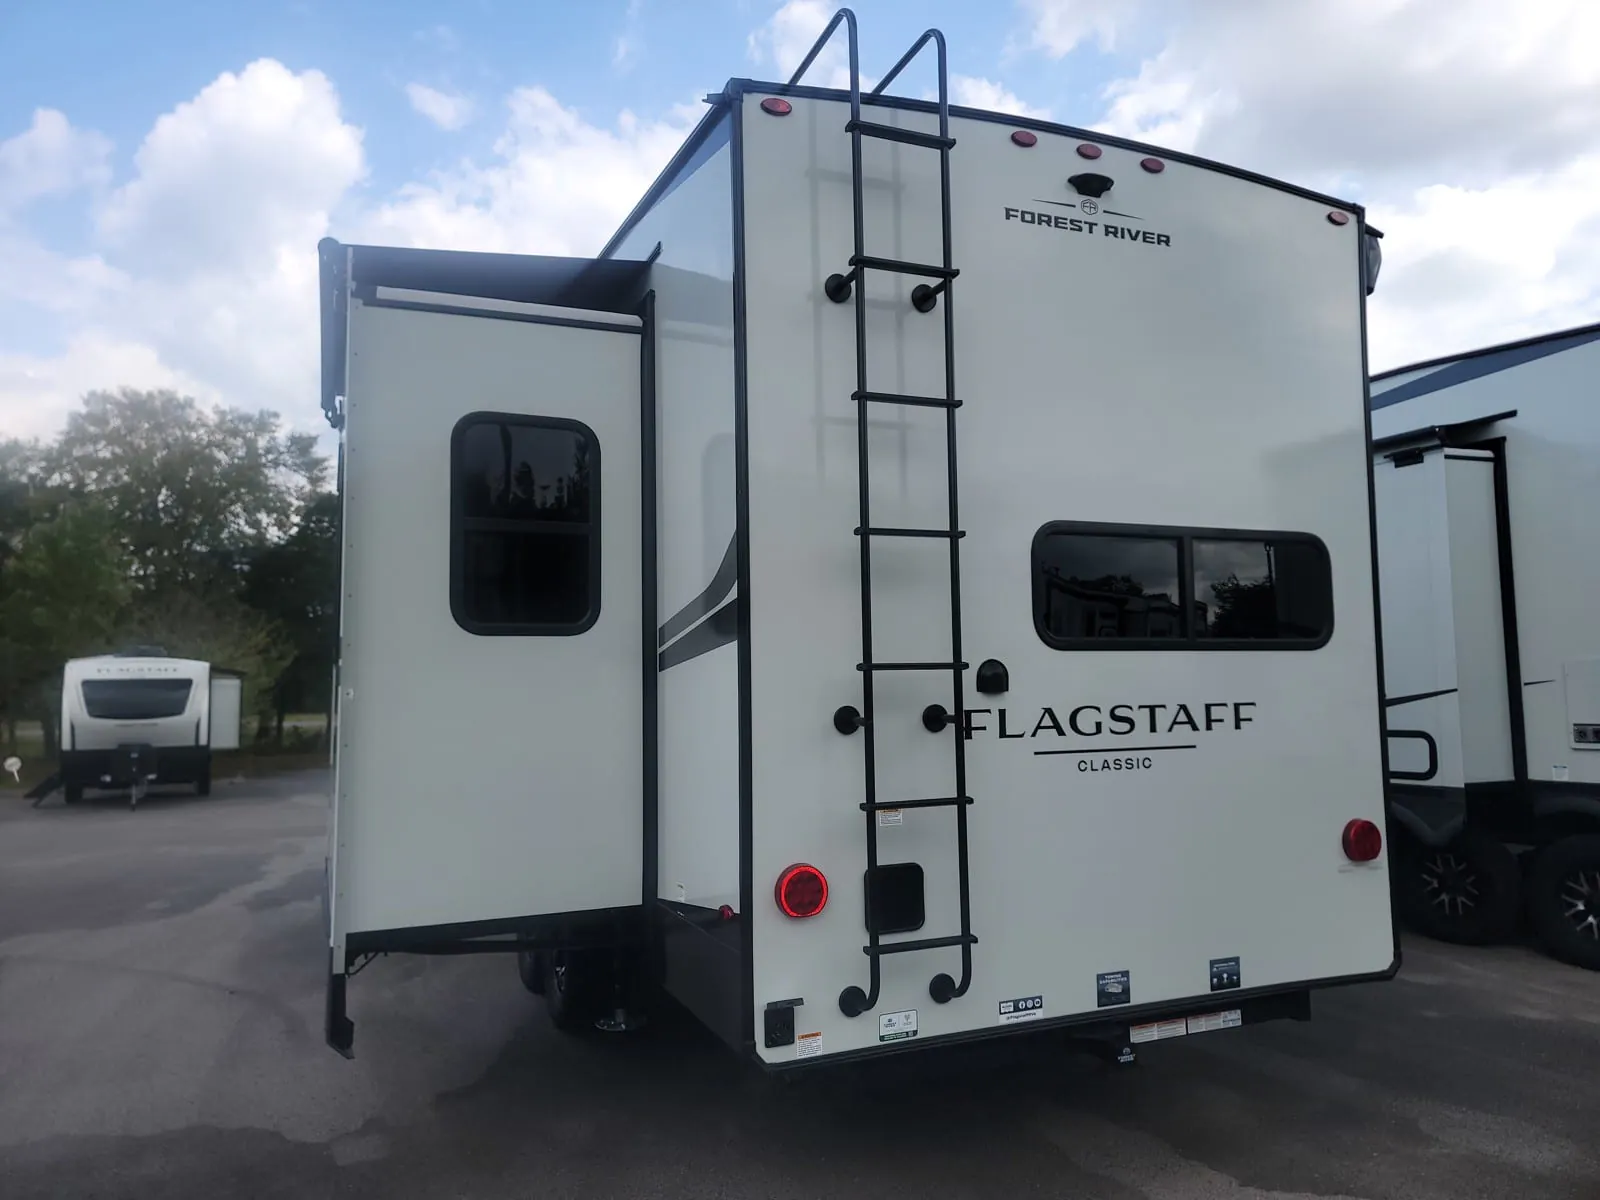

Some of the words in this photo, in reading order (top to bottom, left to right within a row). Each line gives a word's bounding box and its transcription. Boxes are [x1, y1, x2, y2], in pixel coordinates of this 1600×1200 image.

[1004, 206, 1098, 234] FOREST
[1103, 223, 1171, 247] RIVER
[963, 702, 1257, 740] FLAGSTAFF
[1077, 757, 1153, 772] CLASSIC
